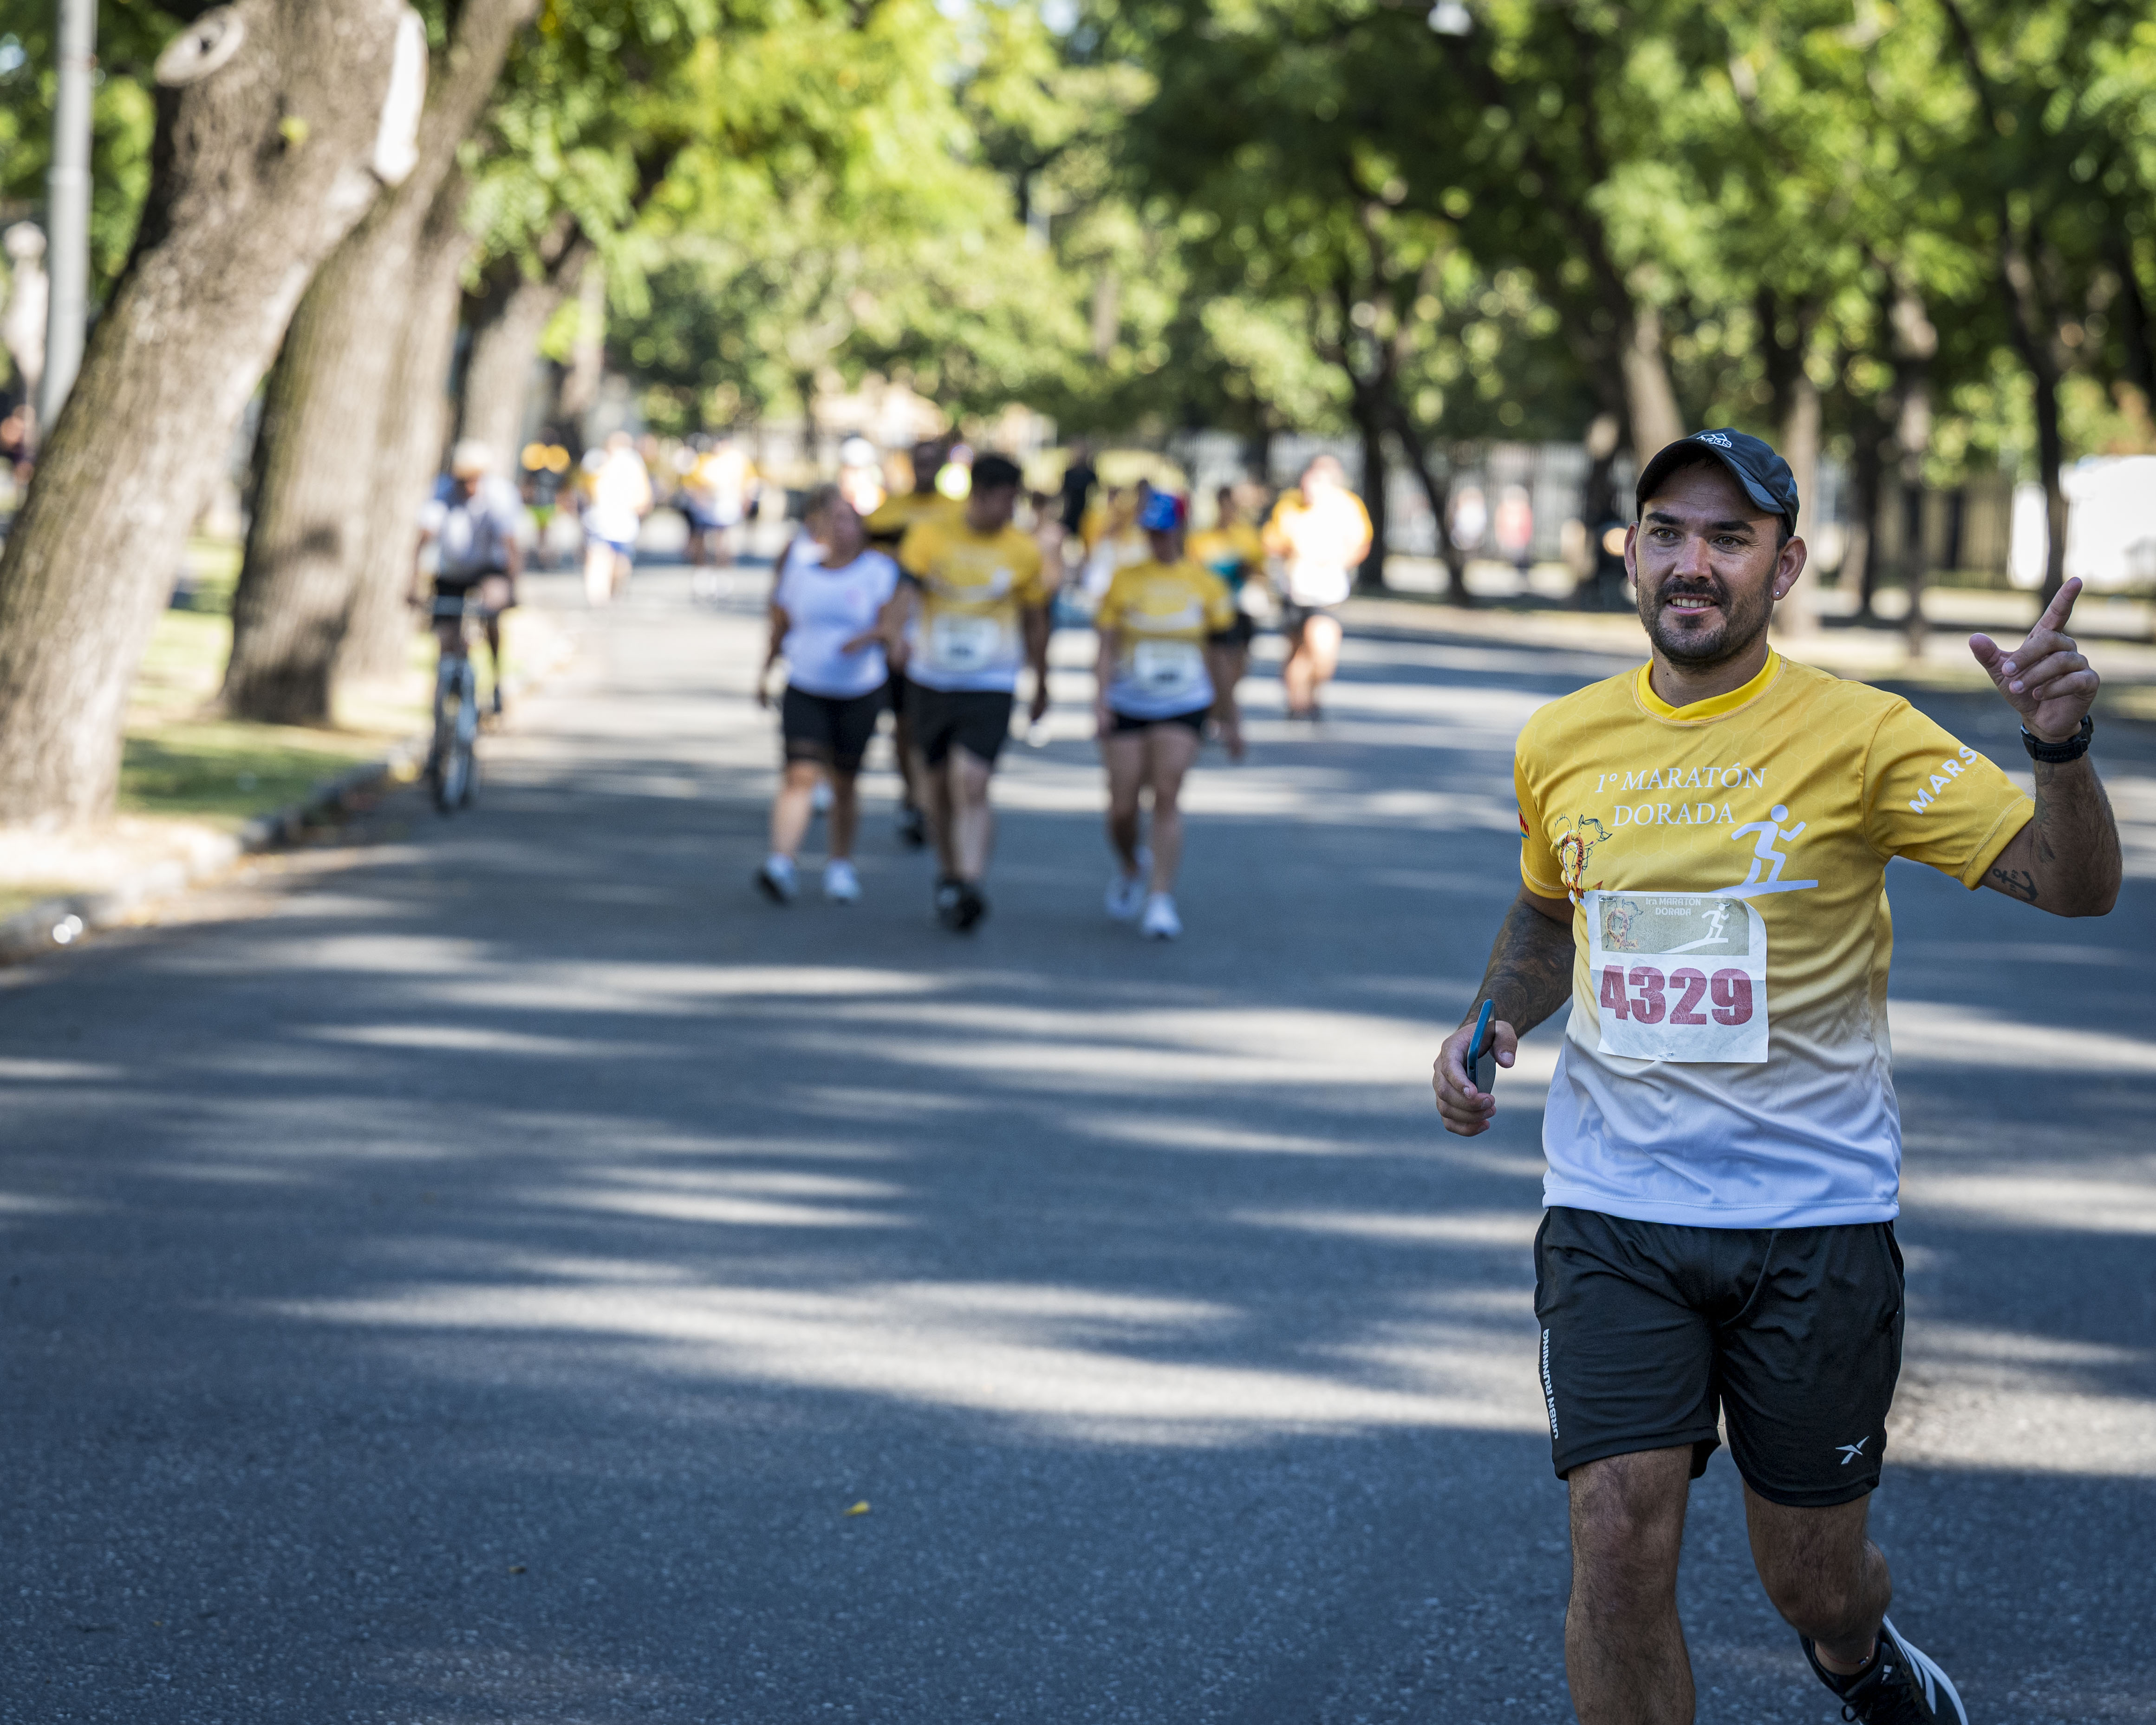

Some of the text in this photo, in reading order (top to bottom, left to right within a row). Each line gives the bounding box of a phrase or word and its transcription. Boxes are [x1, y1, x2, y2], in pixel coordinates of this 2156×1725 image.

[1621, 762, 1767, 791] MARATÓN
[1908, 746, 1977, 815] MARS
[1612, 803, 1735, 826] DORADA
[1655, 907, 1691, 915] DORADA
[1659, 897, 1701, 906] MARATON
[1600, 965, 1752, 1026] 4329
[1543, 1328, 1558, 1439] URBN RUNNING
